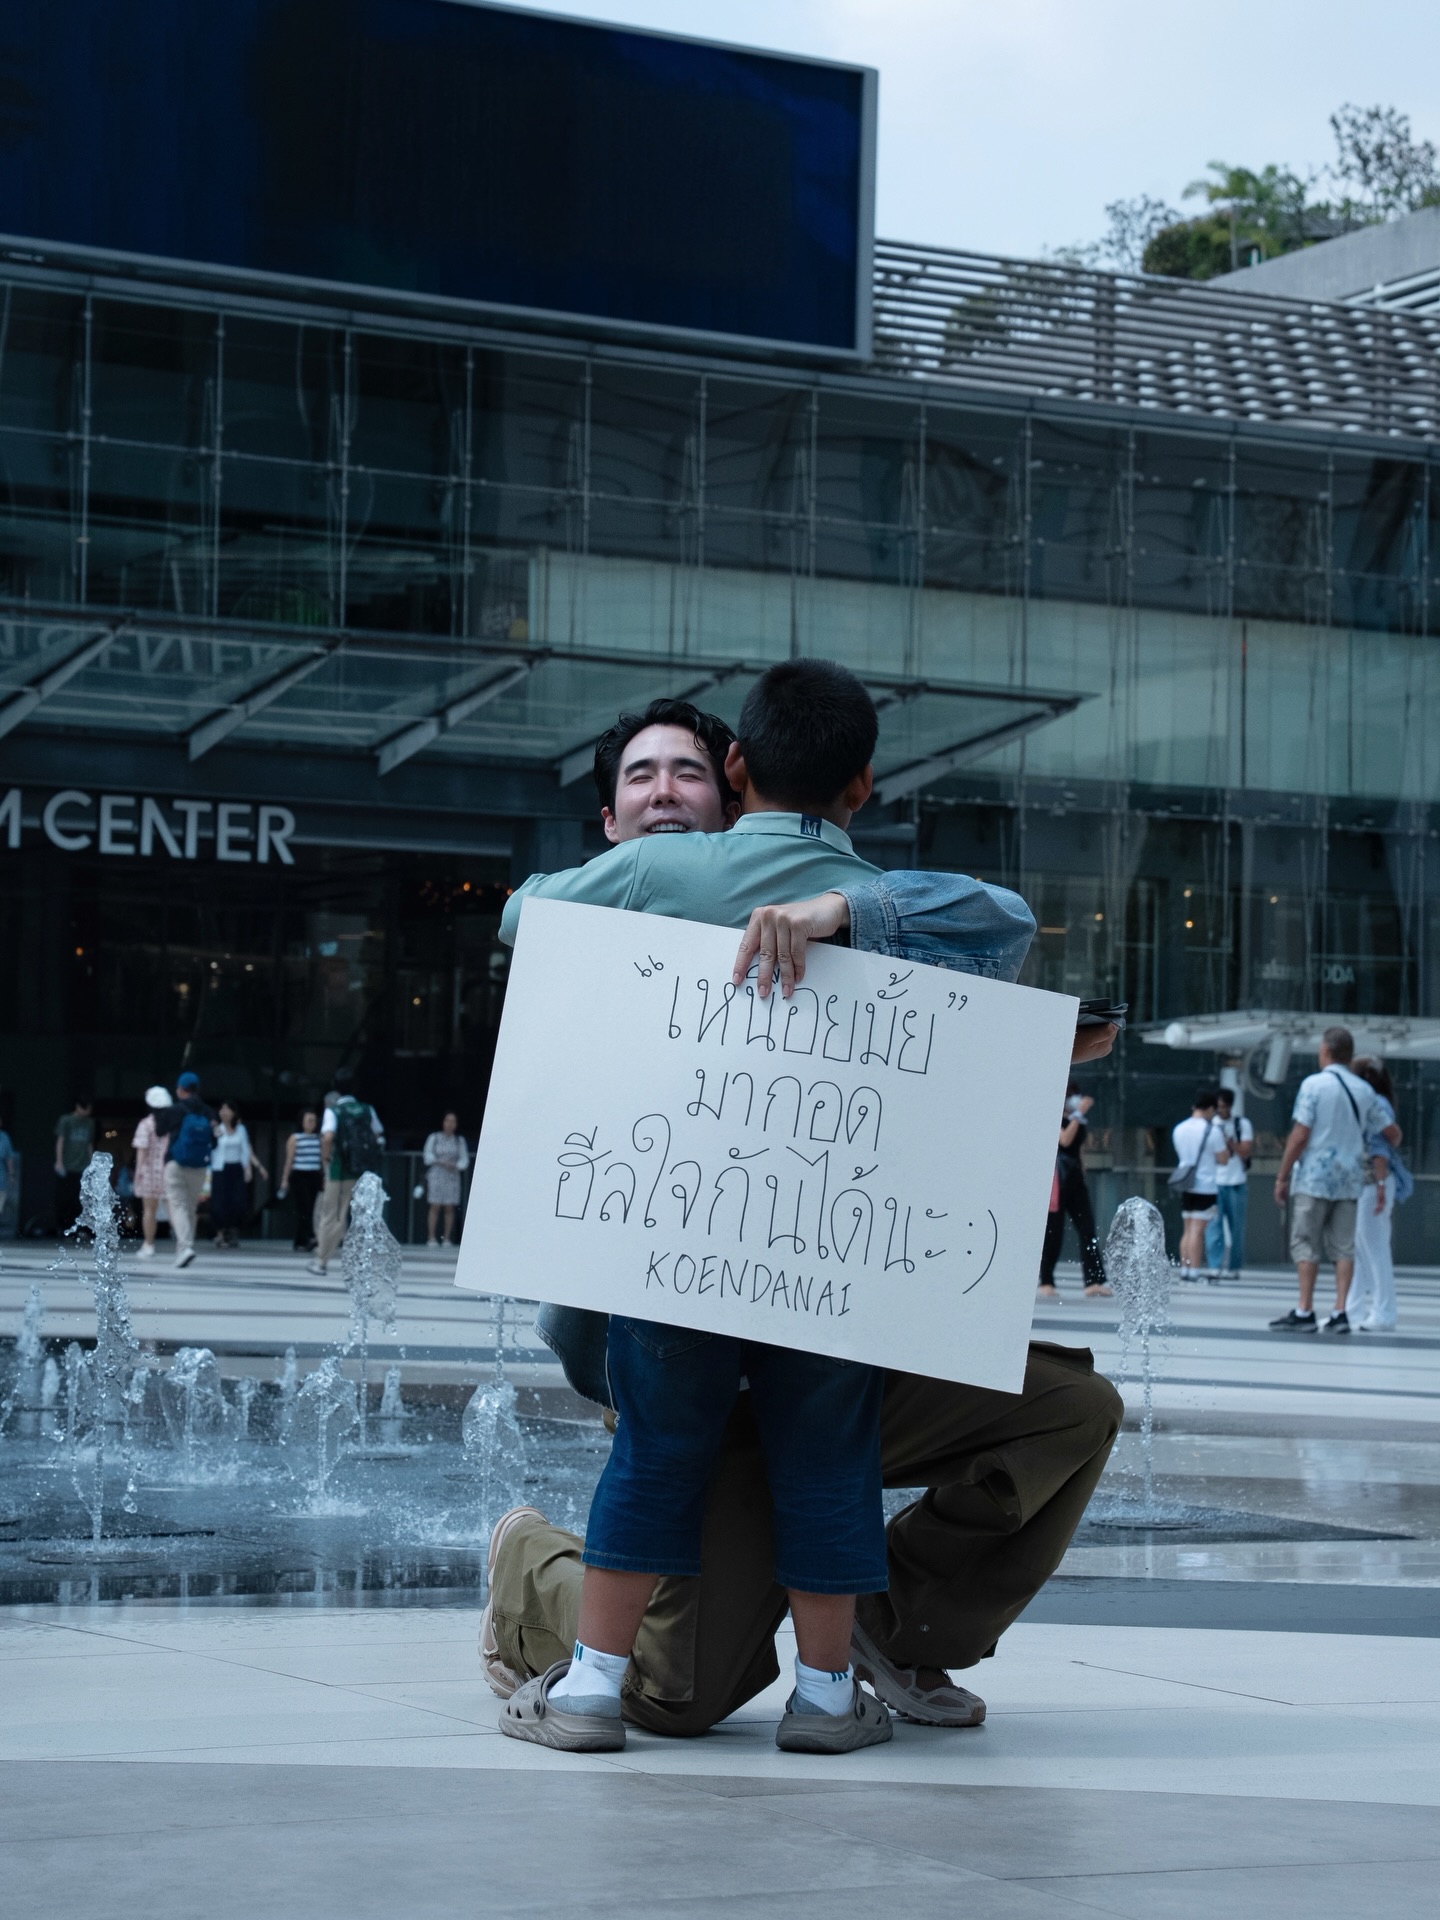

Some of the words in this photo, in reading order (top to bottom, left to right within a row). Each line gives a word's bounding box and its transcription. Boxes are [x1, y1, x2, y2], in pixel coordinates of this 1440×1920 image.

[43, 790, 296, 865] CENTER
[803, 819, 819, 837] M
[633, 954, 968, 1075] “เหนอยมั้ย”
[686, 1068, 883, 1152] มากอด
[645, 1250, 852, 1317] KOENDANAI
